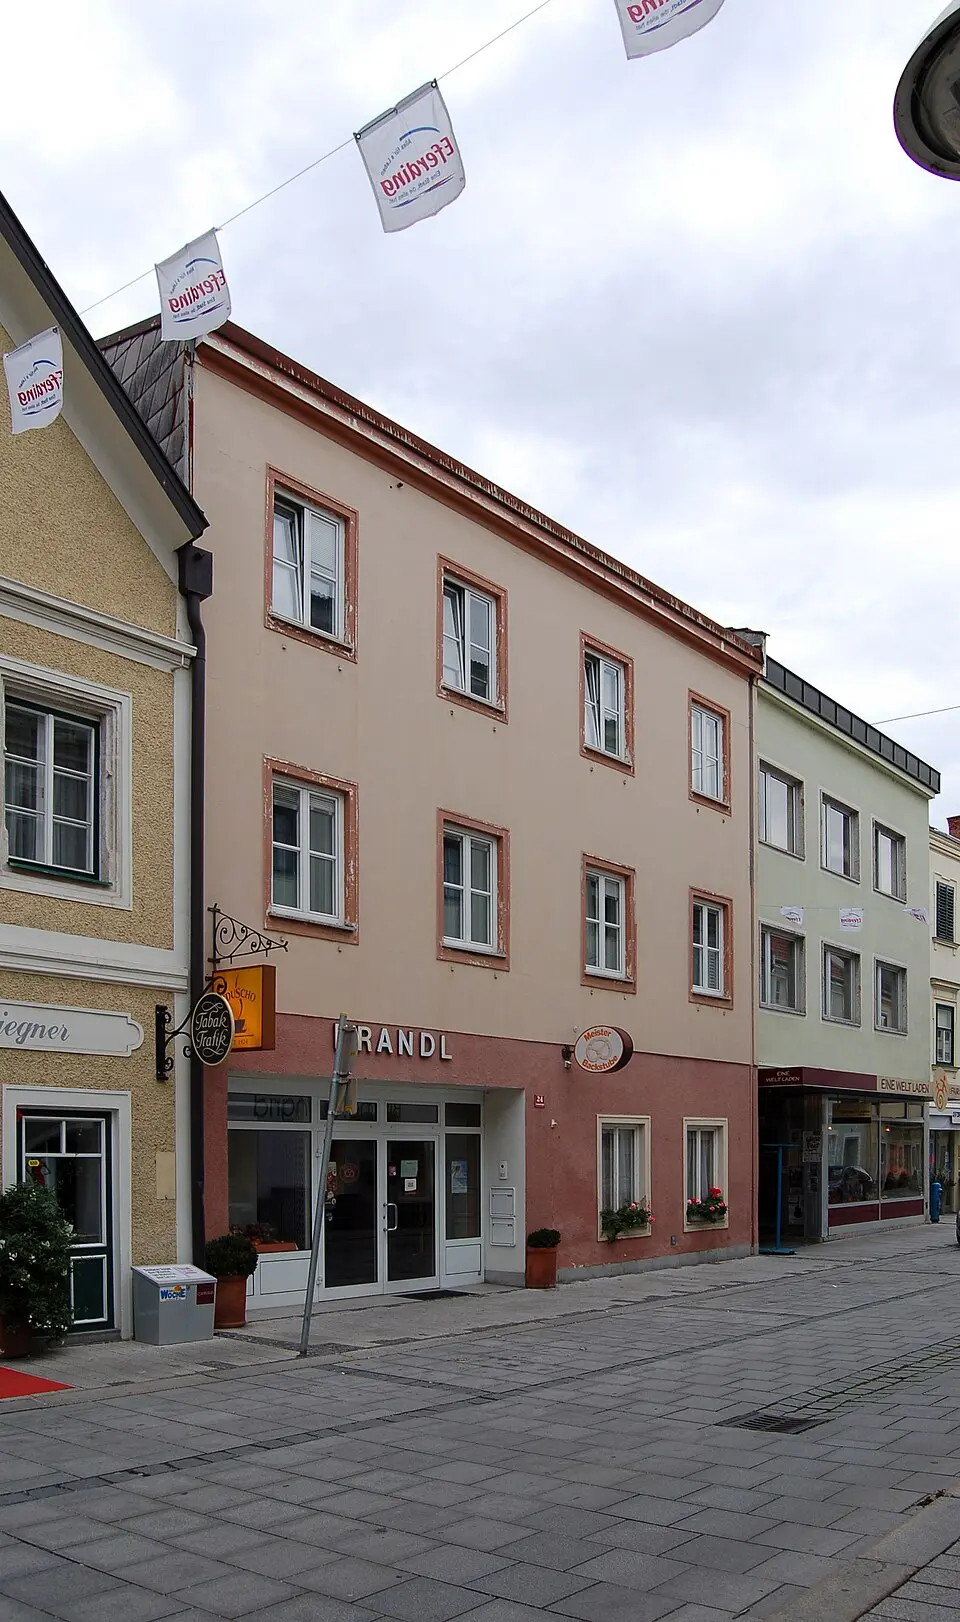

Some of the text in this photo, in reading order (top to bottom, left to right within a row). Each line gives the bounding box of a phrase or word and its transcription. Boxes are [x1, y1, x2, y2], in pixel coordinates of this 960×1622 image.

[224, 987, 256, 1003] DUSCHO
[195, 1010, 229, 1030] Tabak
[196, 1028, 229, 1050] Trafik
[584, 1028, 612, 1041] Meister
[582, 1055, 619, 1070] Backstube
[881, 1078, 930, 1094] EINE WELT LADEN
